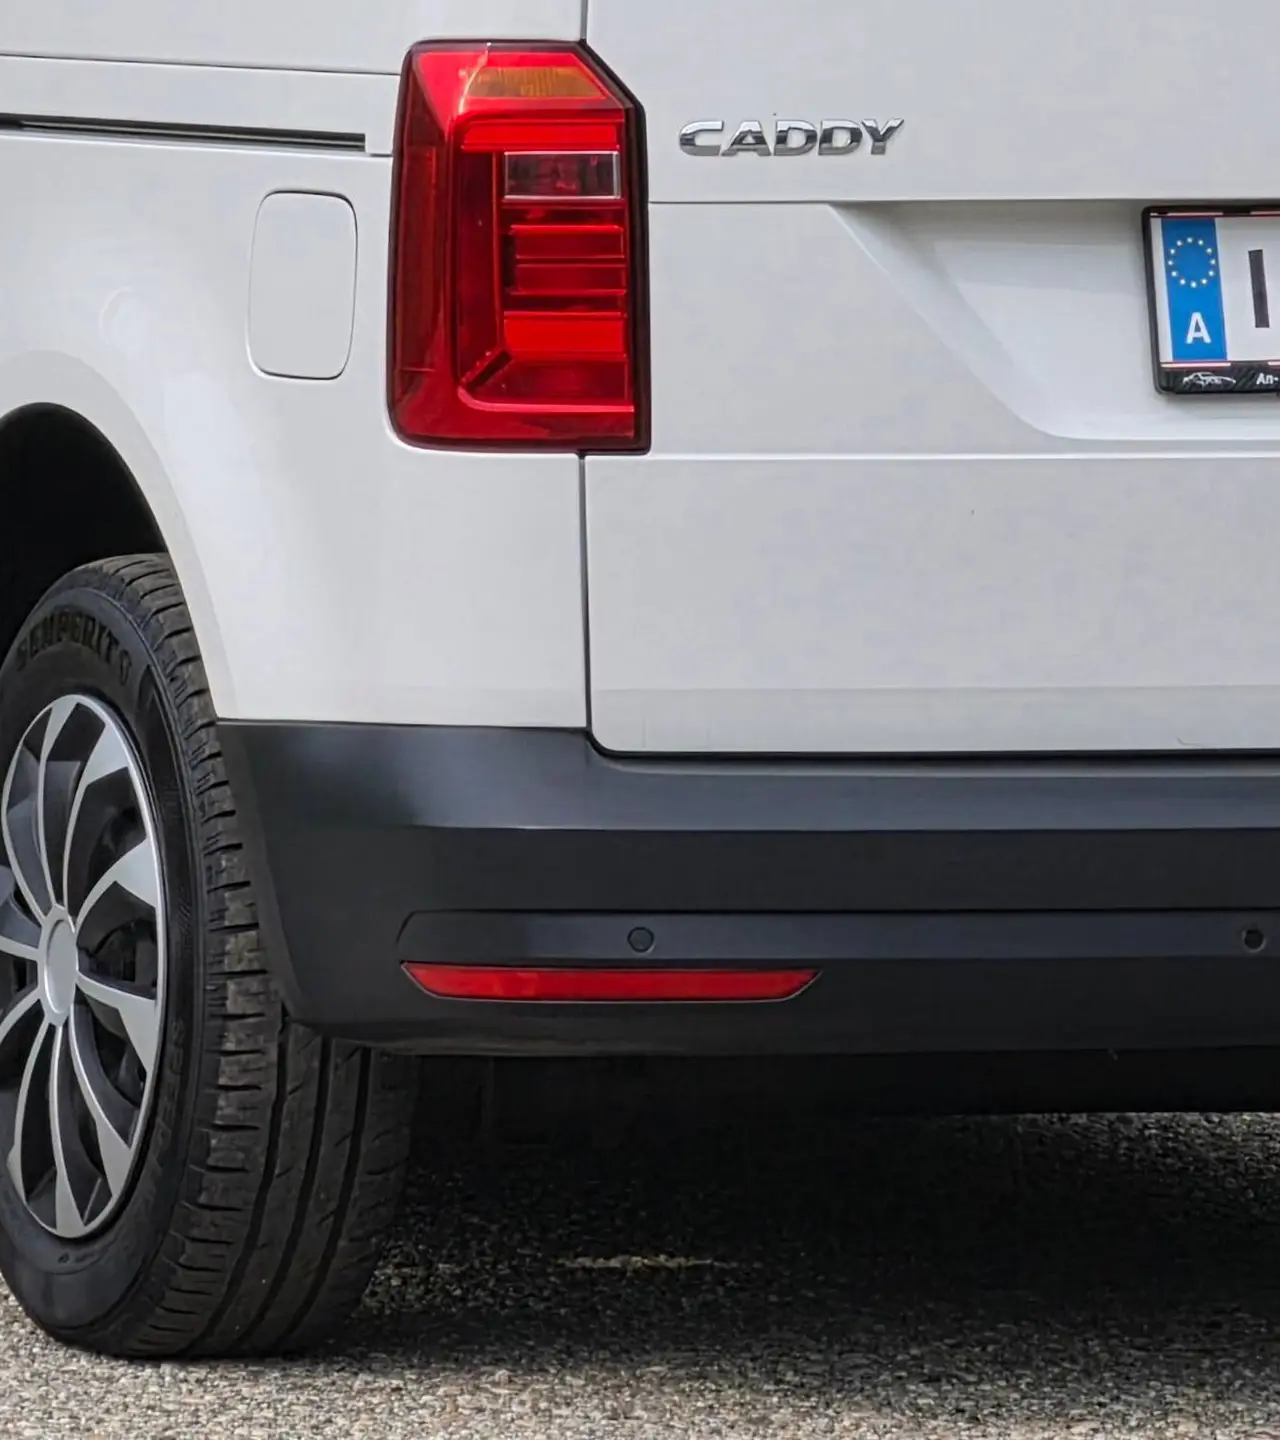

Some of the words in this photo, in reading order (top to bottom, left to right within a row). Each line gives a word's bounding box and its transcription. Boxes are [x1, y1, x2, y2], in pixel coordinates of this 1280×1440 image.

[678, 118, 905, 157] CADDY
[1247, 248, 1270, 329] I
[1185, 311, 1212, 345] A
[1256, 371, 1279, 385] An-
